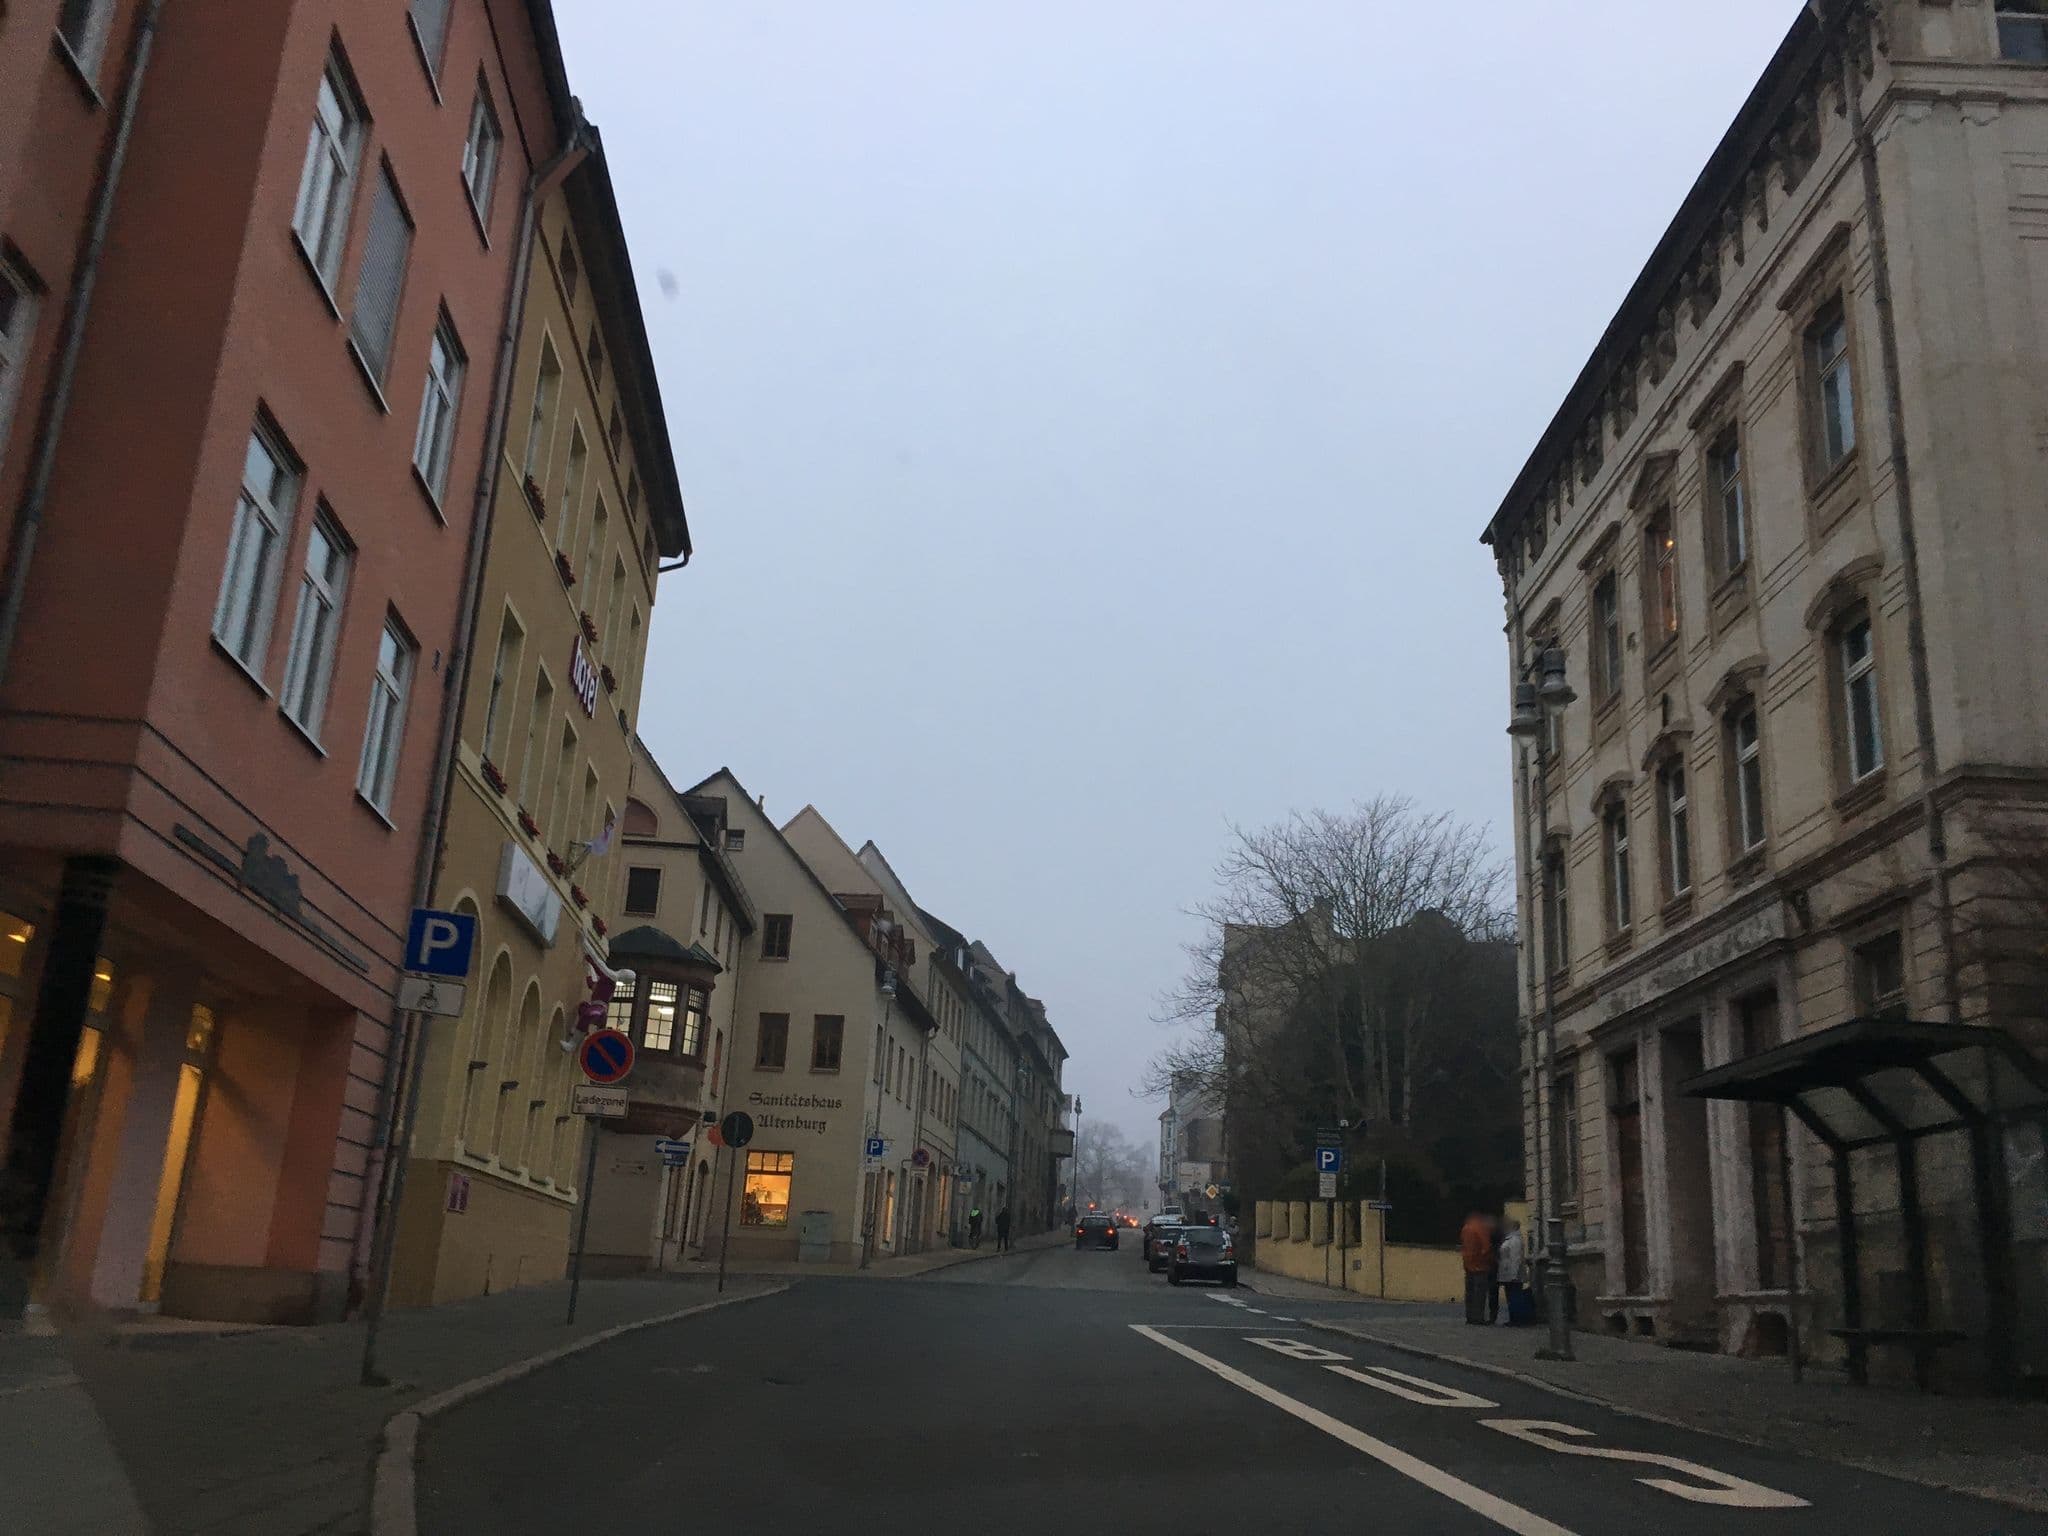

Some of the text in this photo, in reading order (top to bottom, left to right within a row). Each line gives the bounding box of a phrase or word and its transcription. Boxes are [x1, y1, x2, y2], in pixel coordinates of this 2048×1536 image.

[419, 918, 459, 965] P
[576, 1094, 625, 1107] Ladezone
[749, 1092, 842, 1109] Sanitätshaus
[757, 1114, 827, 1135] Altenburg
[870, 1140, 880, 1153] P
[1322, 1151, 1335, 1169] P
[1243, 1336, 1814, 1509] BUS
